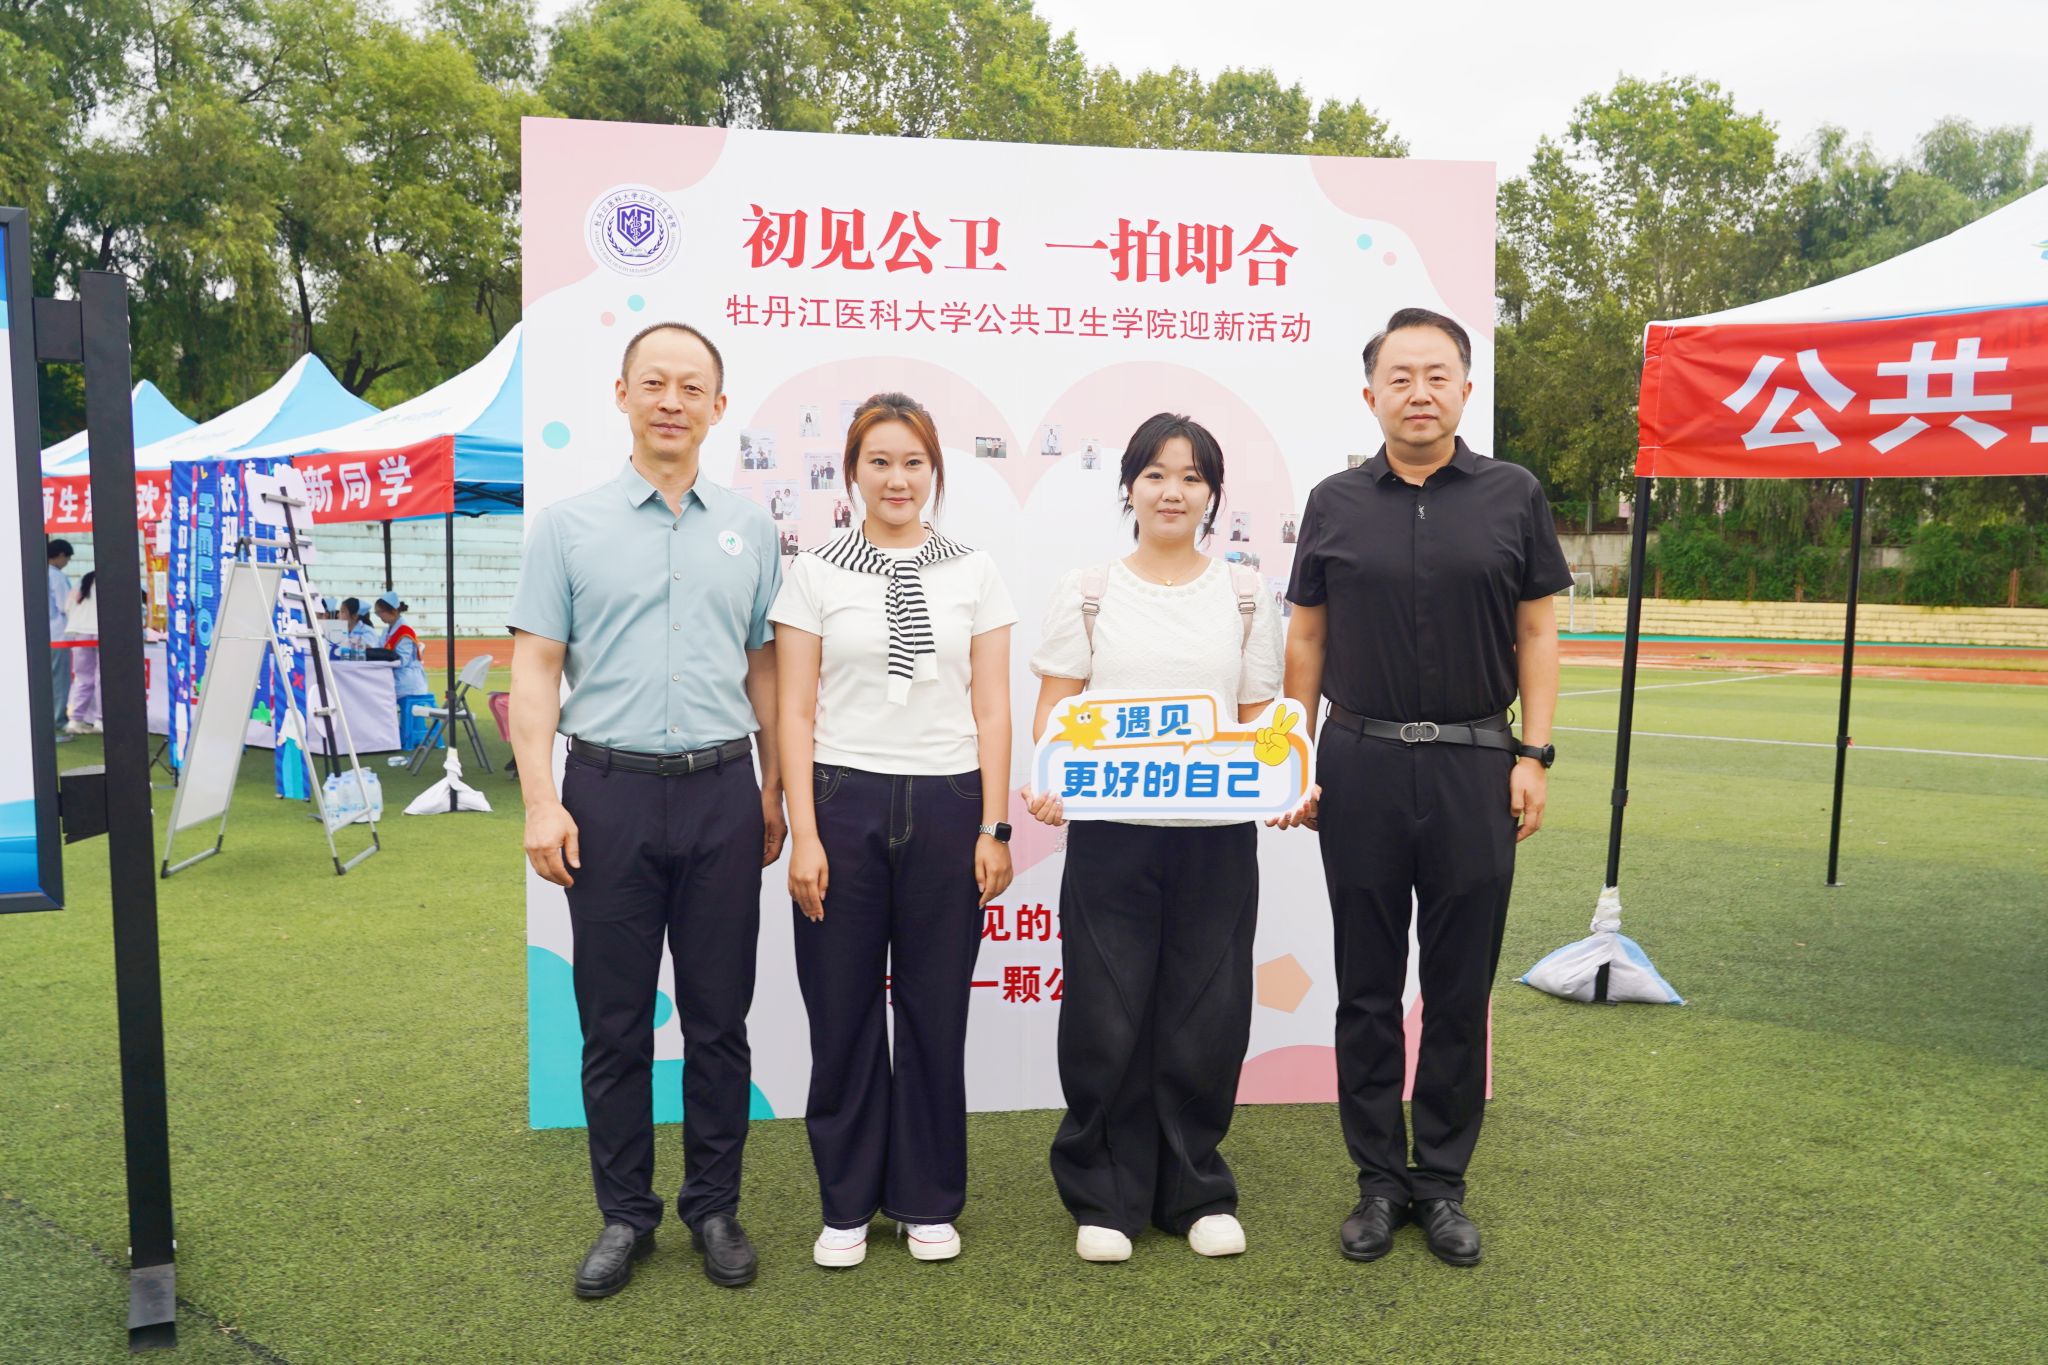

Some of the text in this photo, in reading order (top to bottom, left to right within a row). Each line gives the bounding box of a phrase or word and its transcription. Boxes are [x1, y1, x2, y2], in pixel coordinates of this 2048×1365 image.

[741, 203, 1007, 275] 初见公卫
[1045, 217, 1299, 287] 一拍即合
[725, 294, 1311, 343] 牡丹江医科大学公共卫生学院迎新活动
[1721, 337, 2048, 455] 公共
[197, 493, 215, 647] HELLO
[1115, 704, 1192, 738] 遇见
[1062, 760, 1260, 798] 更好的自己
[981, 903, 1062, 942] 见的
